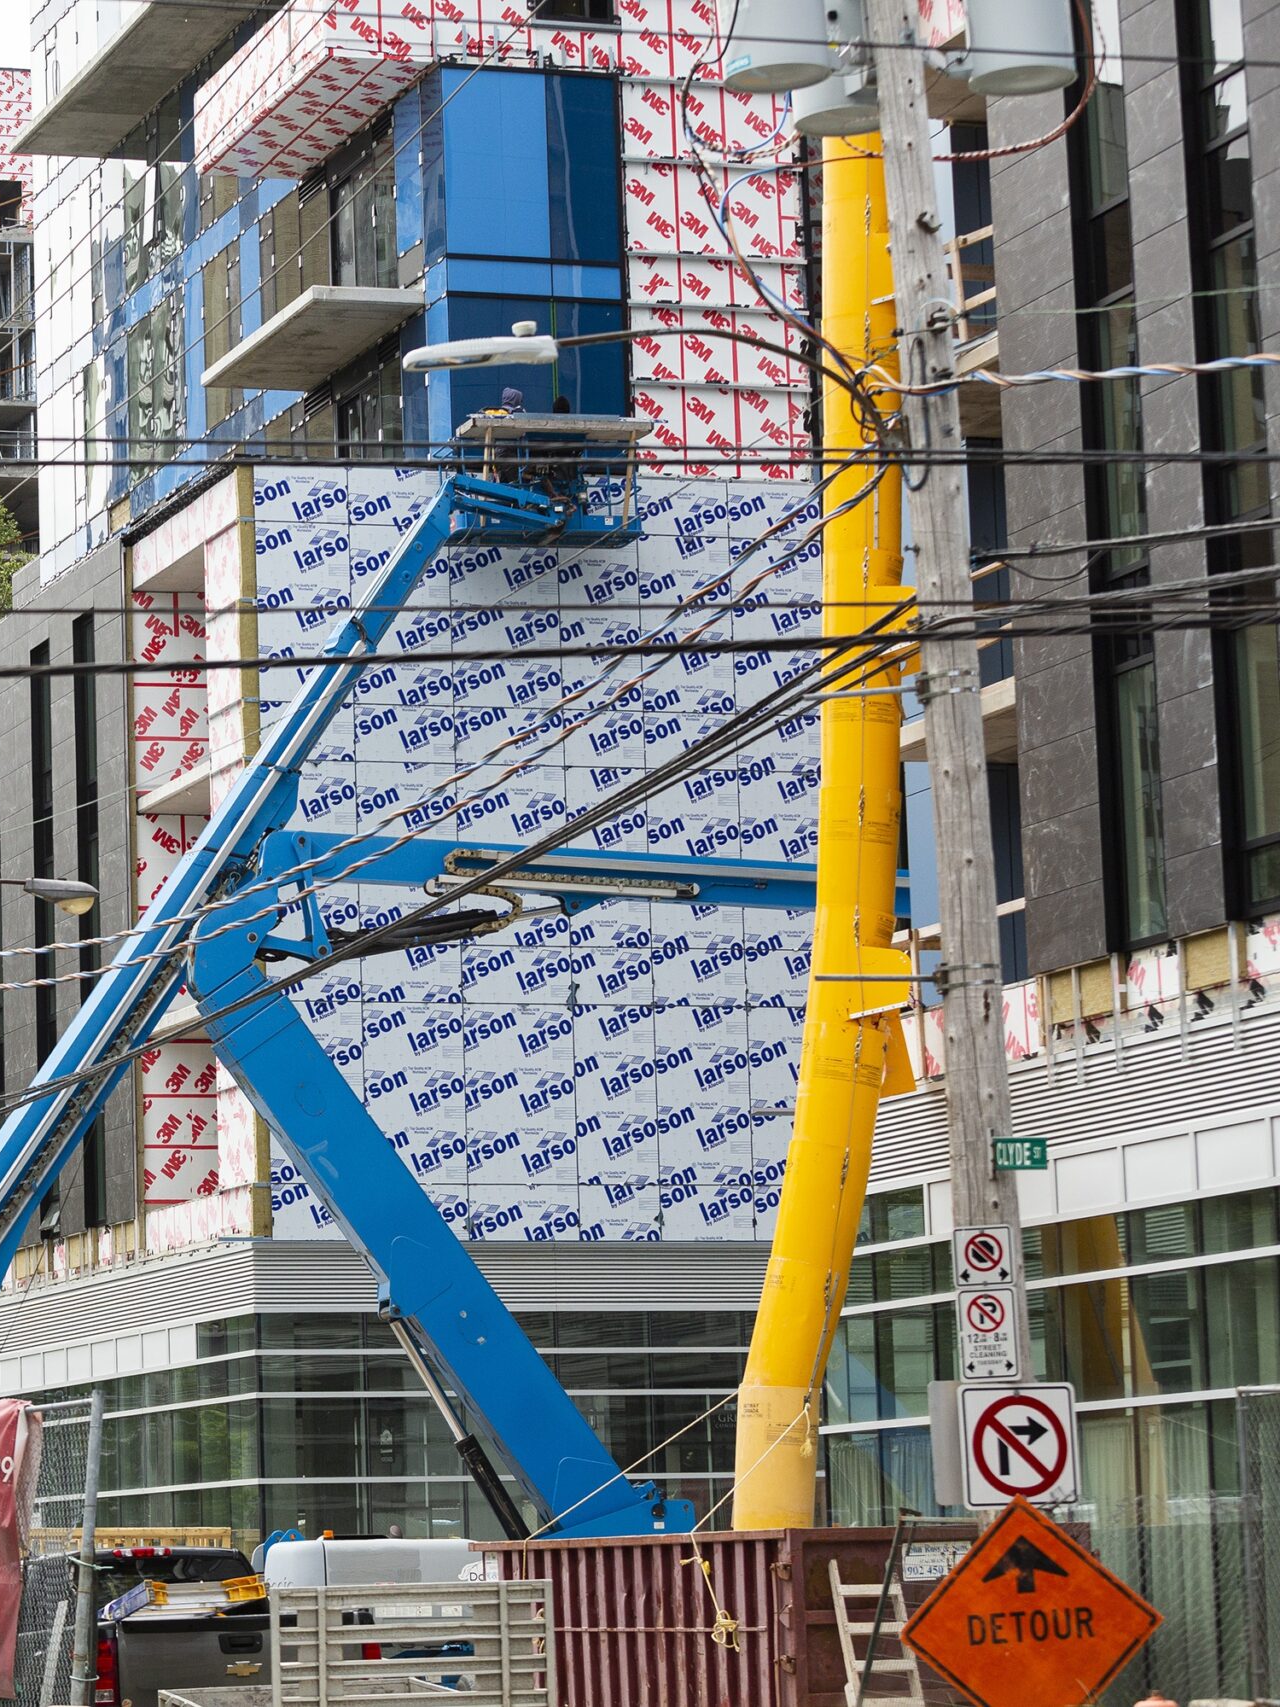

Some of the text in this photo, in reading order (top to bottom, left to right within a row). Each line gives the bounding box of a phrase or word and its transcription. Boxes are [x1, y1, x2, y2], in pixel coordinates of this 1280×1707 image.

[639, 28, 668, 55] 3M
[674, 28, 703, 55] 3M
[641, 89, 670, 116] 3M
[624, 118, 653, 145] 3M
[744, 111, 772, 138] 3M
[626, 179, 655, 206] 3M
[646, 212, 675, 239] 3M
[680, 212, 709, 240] 3M
[731, 202, 759, 228] 3M
[683, 273, 711, 300] 3M
[684, 334, 713, 362] 3M
[757, 357, 786, 383] 3M
[634, 392, 663, 418] 3M
[686, 397, 715, 425] 3M
[740, 389, 769, 413] 3M
[706, 430, 735, 457] 3M
[760, 418, 788, 446] 3M
[135, 706, 157, 735] 3M
[140, 742, 165, 771] 3M
[166, 1063, 191, 1093] 3M
[156, 1114, 182, 1144] 3M
[161, 1150, 187, 1180] 3M
[996, 1142, 1031, 1166] CLYDE
[969, 1351, 1007, 1359] CLEANING
[907, 1566, 924, 1575] 902
[967, 1606, 1095, 1646] DETOUR
